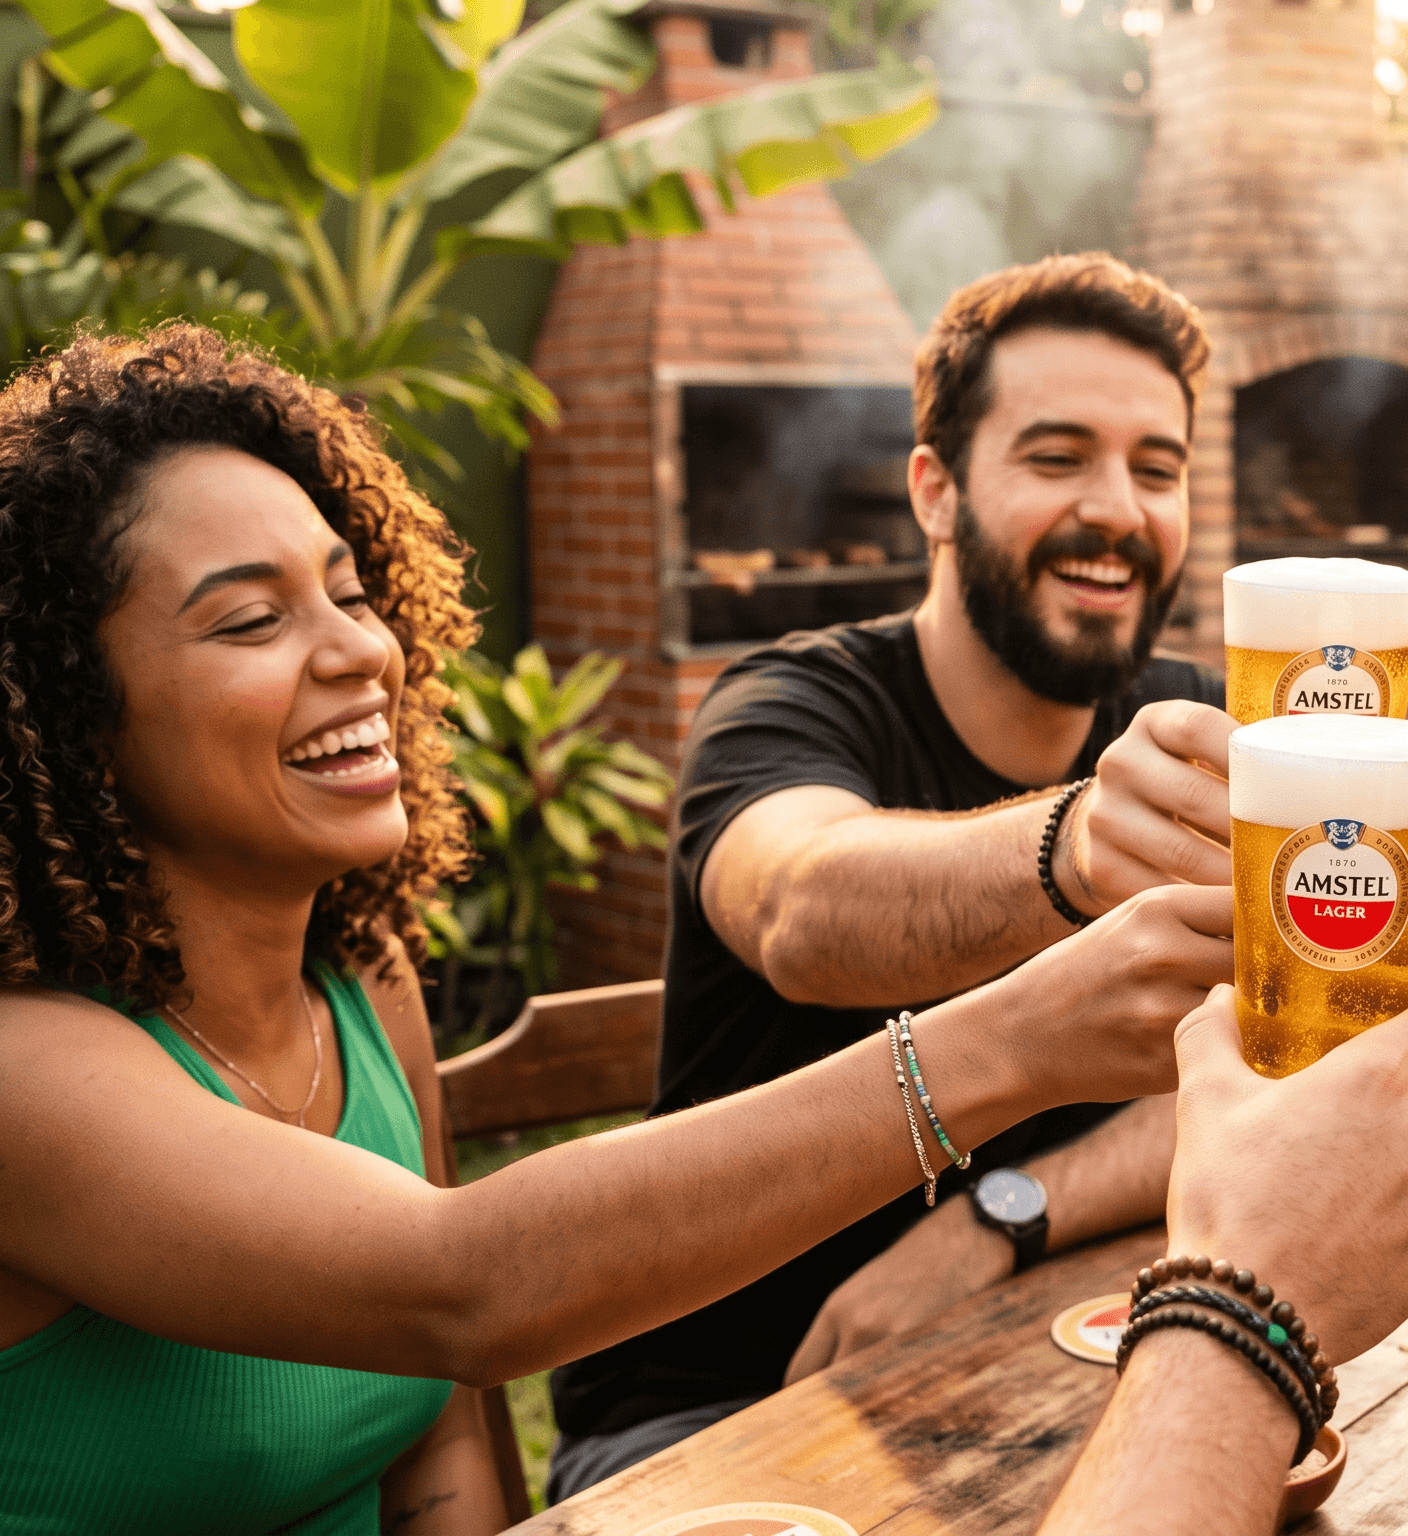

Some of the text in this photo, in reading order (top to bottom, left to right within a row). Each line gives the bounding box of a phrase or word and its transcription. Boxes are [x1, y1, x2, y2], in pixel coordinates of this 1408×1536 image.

[1327, 678, 1348, 686] 1870
[1294, 690, 1374, 710] AMSTEL
[1329, 859, 1357, 867] 1870
[1294, 871, 1390, 897] AMSTEL
[1313, 903, 1367, 919] LAGER
